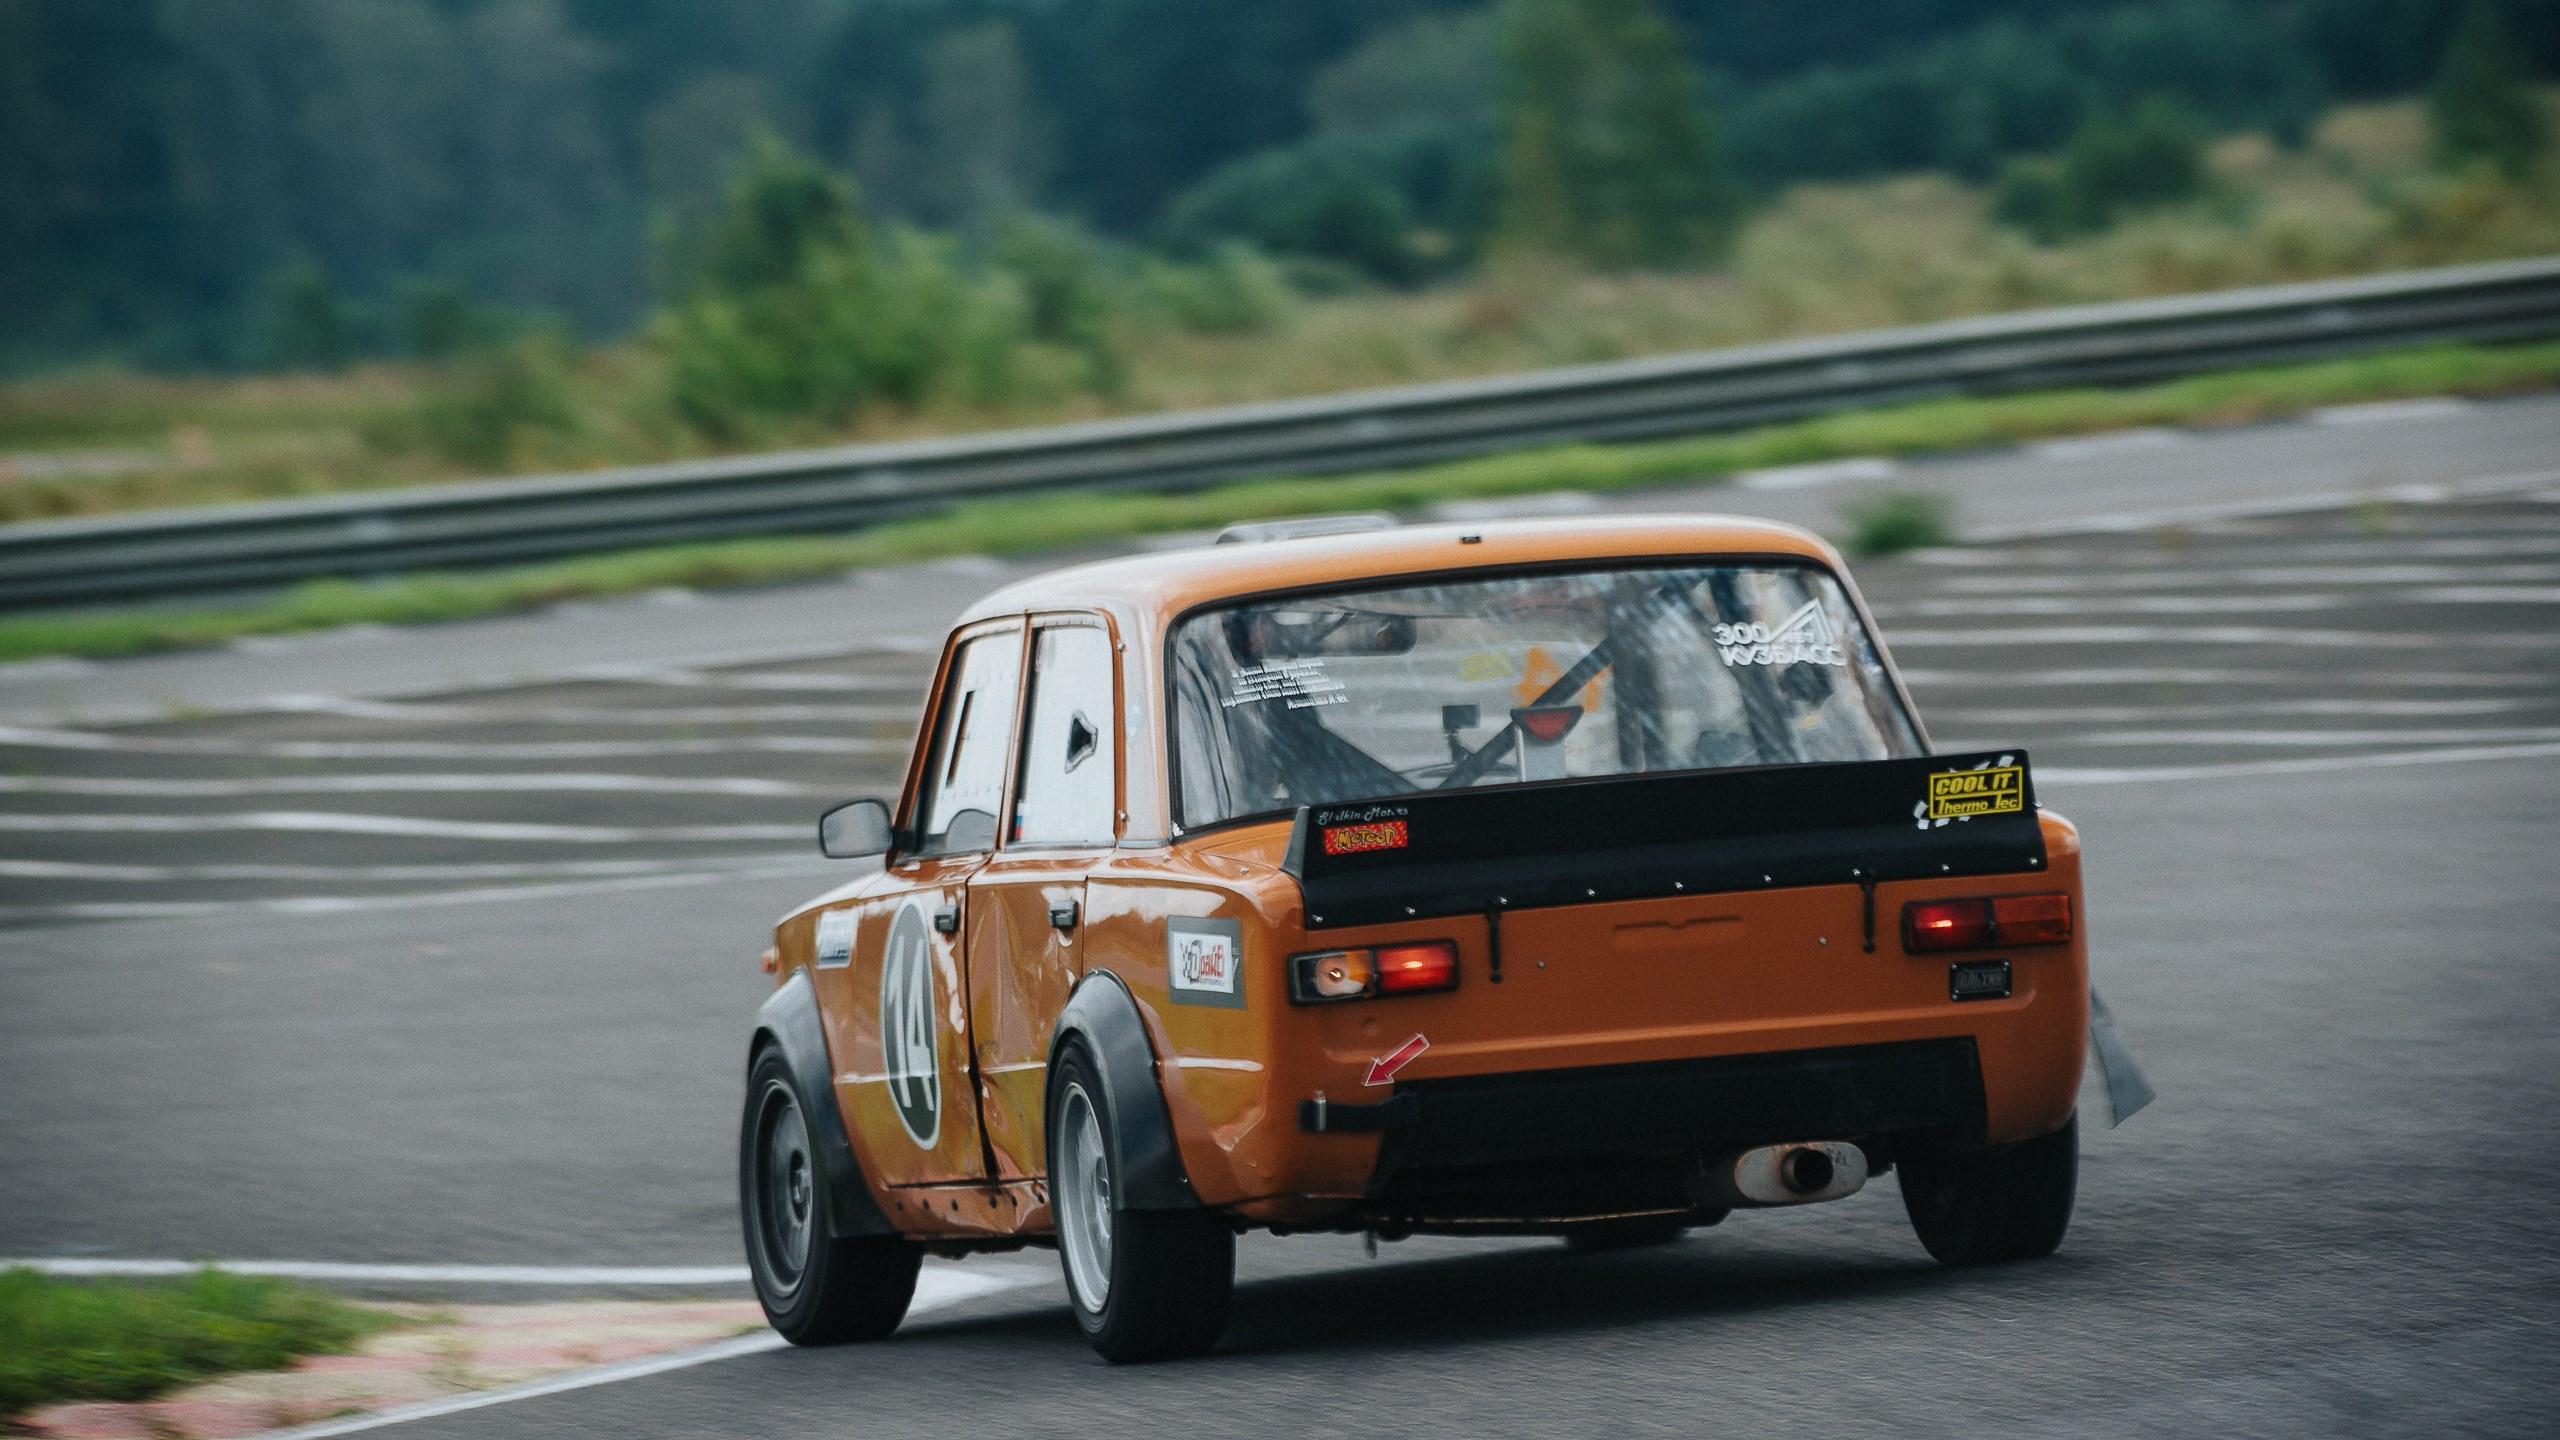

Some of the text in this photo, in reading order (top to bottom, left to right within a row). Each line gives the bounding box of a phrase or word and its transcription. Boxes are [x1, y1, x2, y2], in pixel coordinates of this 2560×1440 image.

[1711, 621, 1772, 646] 300
[1935, 773, 2013, 796] COOL IT
[1936, 793, 2018, 815] Thermo Tec
[888, 934, 936, 1112] 14
